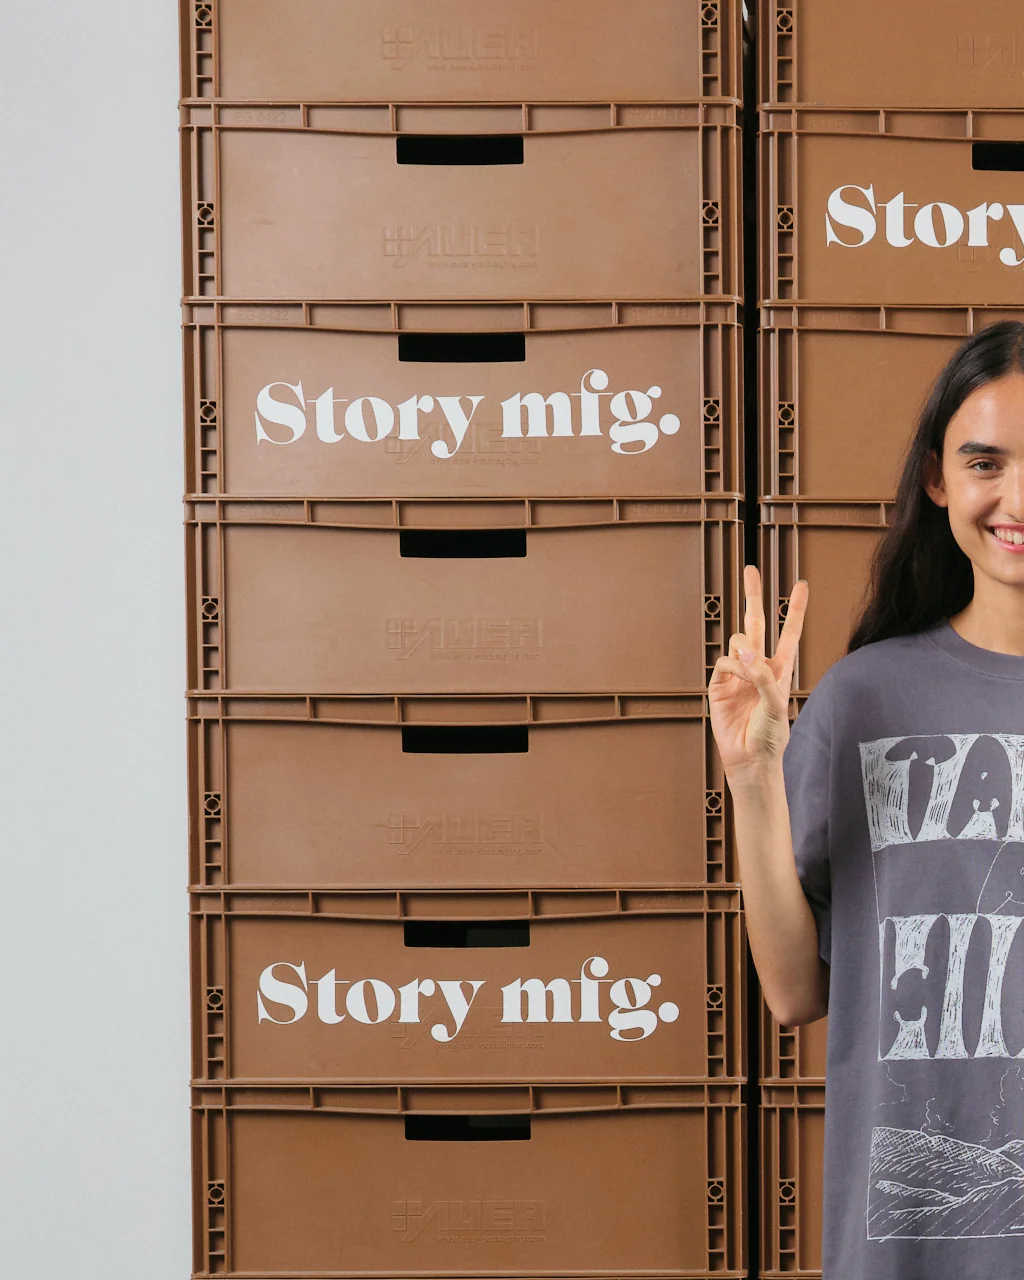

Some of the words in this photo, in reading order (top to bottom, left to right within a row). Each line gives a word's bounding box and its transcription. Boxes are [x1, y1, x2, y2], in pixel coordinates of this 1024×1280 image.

[254, 380, 485, 459] Story
[500, 369, 681, 455] mfg.
[257, 960, 487, 1043] Story
[500, 956, 680, 1042] mfg.
